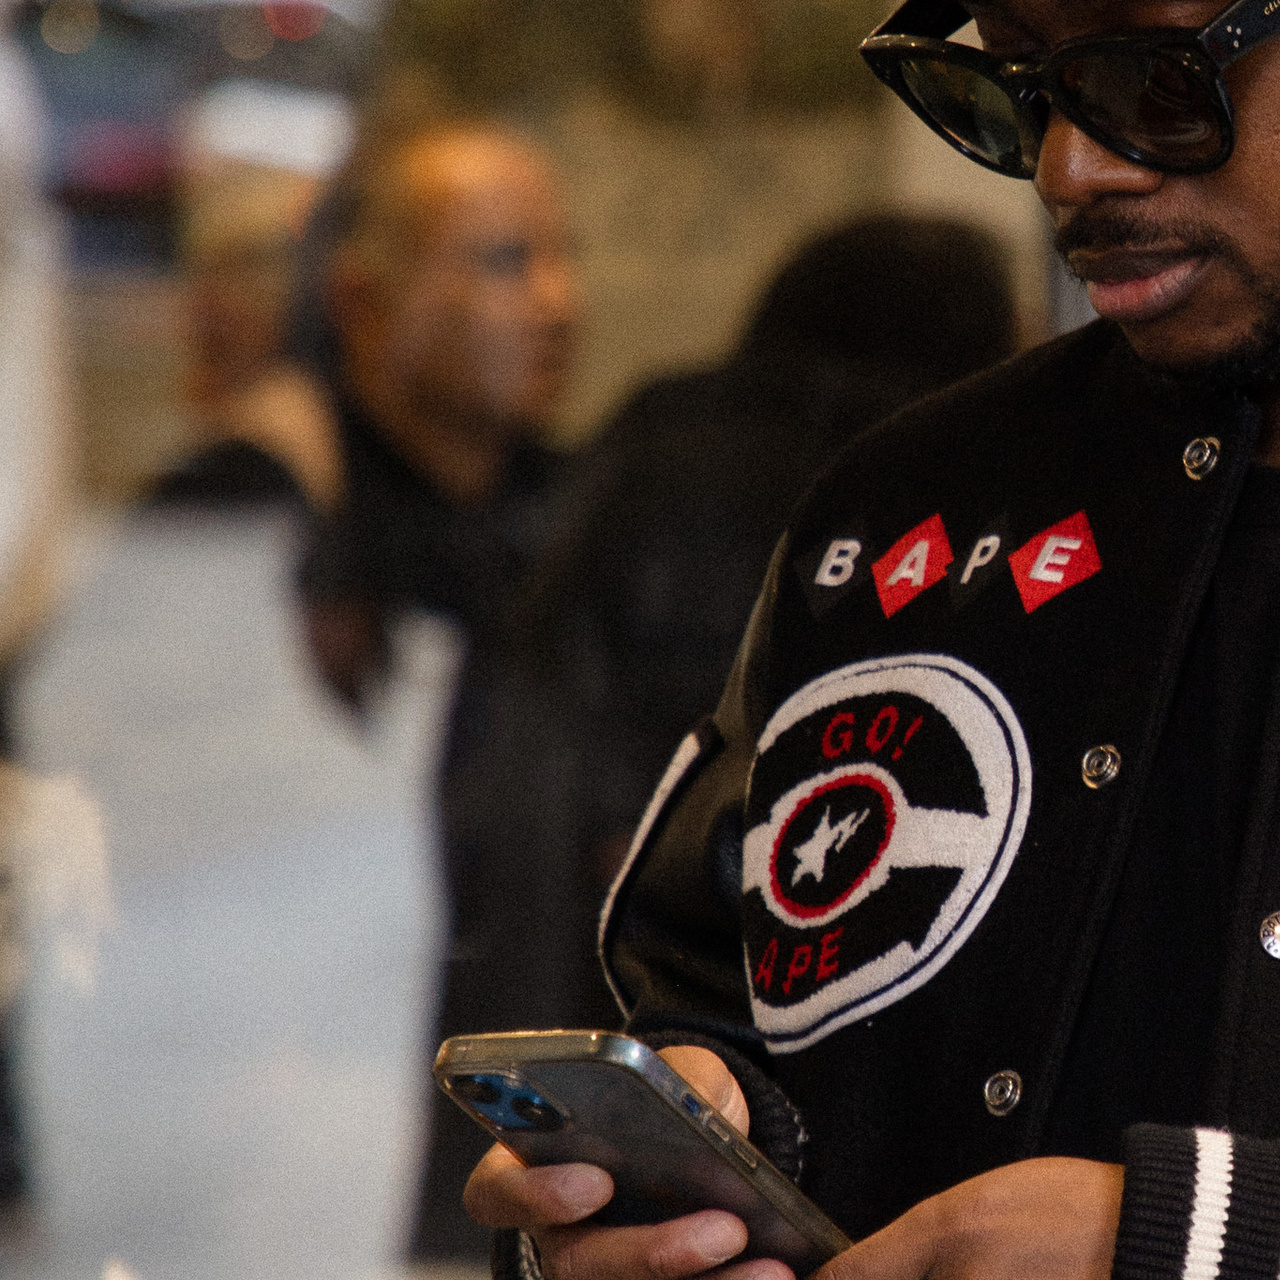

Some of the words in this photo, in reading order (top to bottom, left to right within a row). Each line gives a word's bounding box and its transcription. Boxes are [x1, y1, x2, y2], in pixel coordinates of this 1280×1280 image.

[813, 532, 1084, 587] BAPE
[821, 705, 924, 762] GO!
[754, 926, 845, 995] APE
